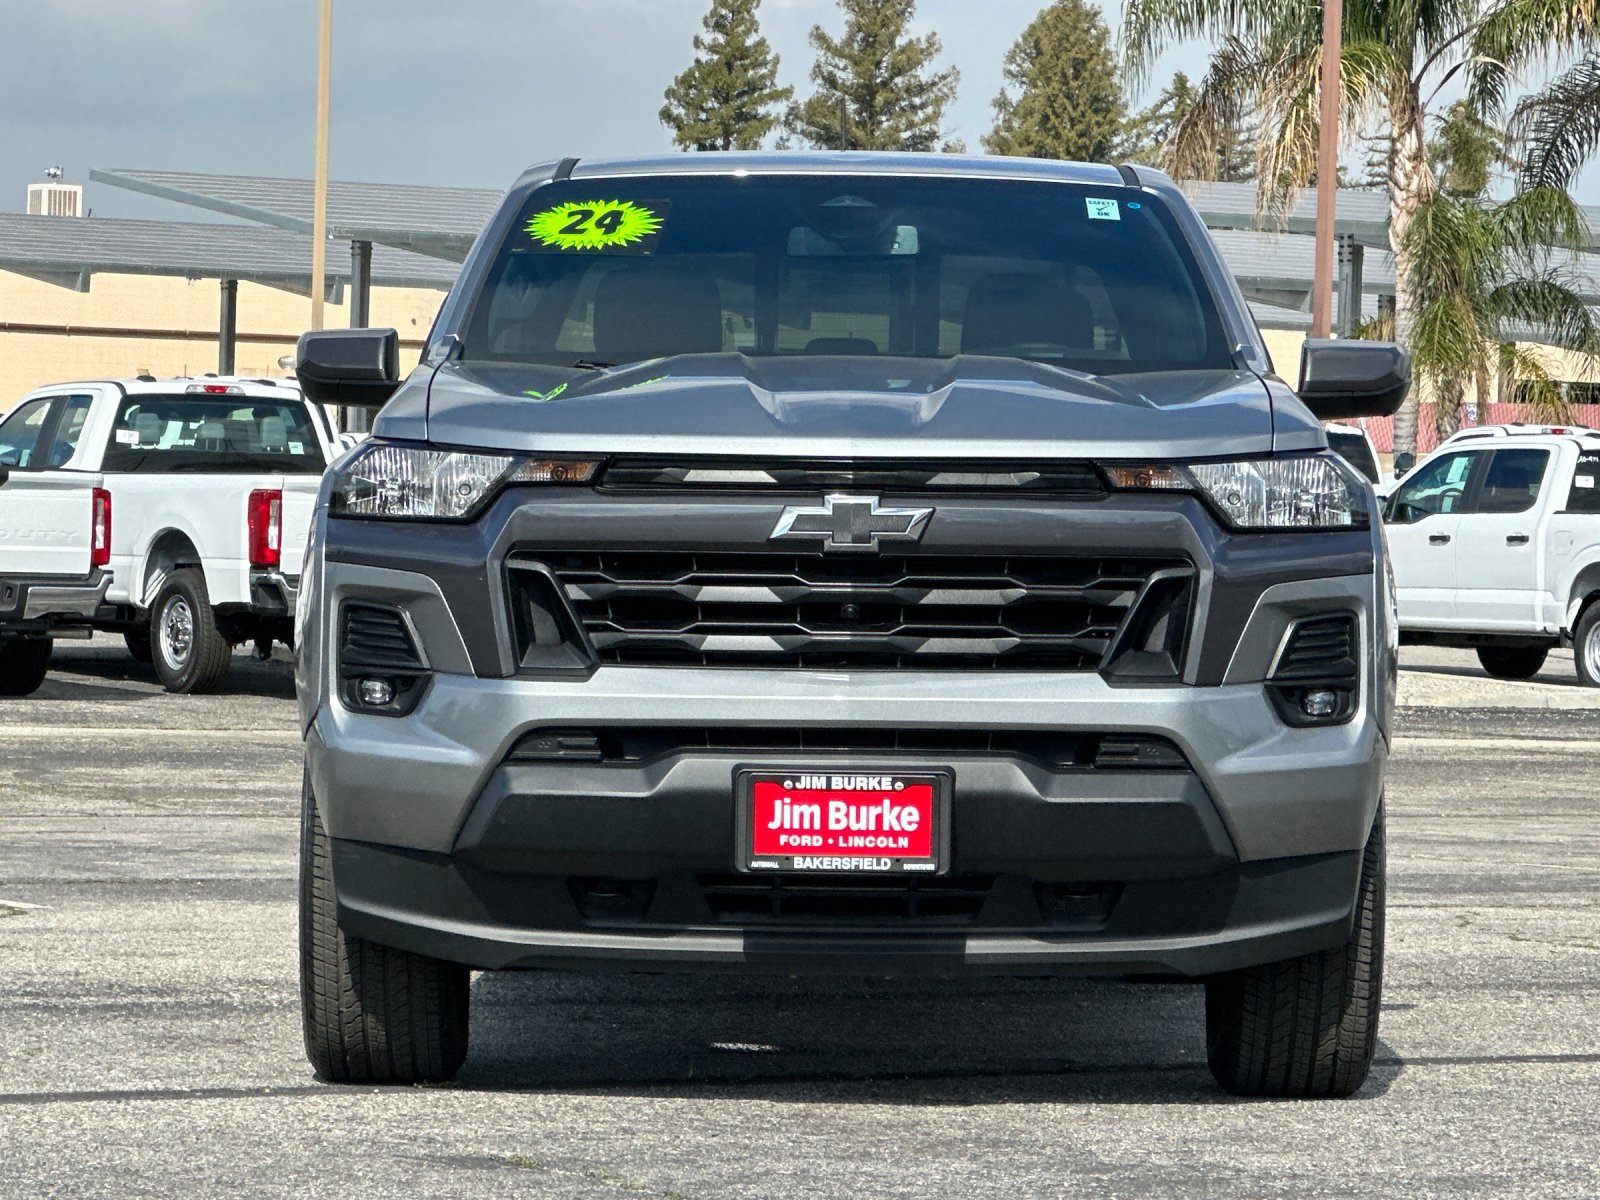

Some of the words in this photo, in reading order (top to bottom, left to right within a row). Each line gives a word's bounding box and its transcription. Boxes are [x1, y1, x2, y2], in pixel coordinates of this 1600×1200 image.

[559, 209, 625, 236] 24
[795, 776, 827, 790] JIM
[831, 777, 893, 791] BURKE
[767, 797, 821, 830] Jim
[828, 799, 920, 832] Burke
[779, 835, 823, 847] FORD
[838, 836, 909, 848] LINCOLN
[793, 857, 892, 871] BAKERSFIELD
